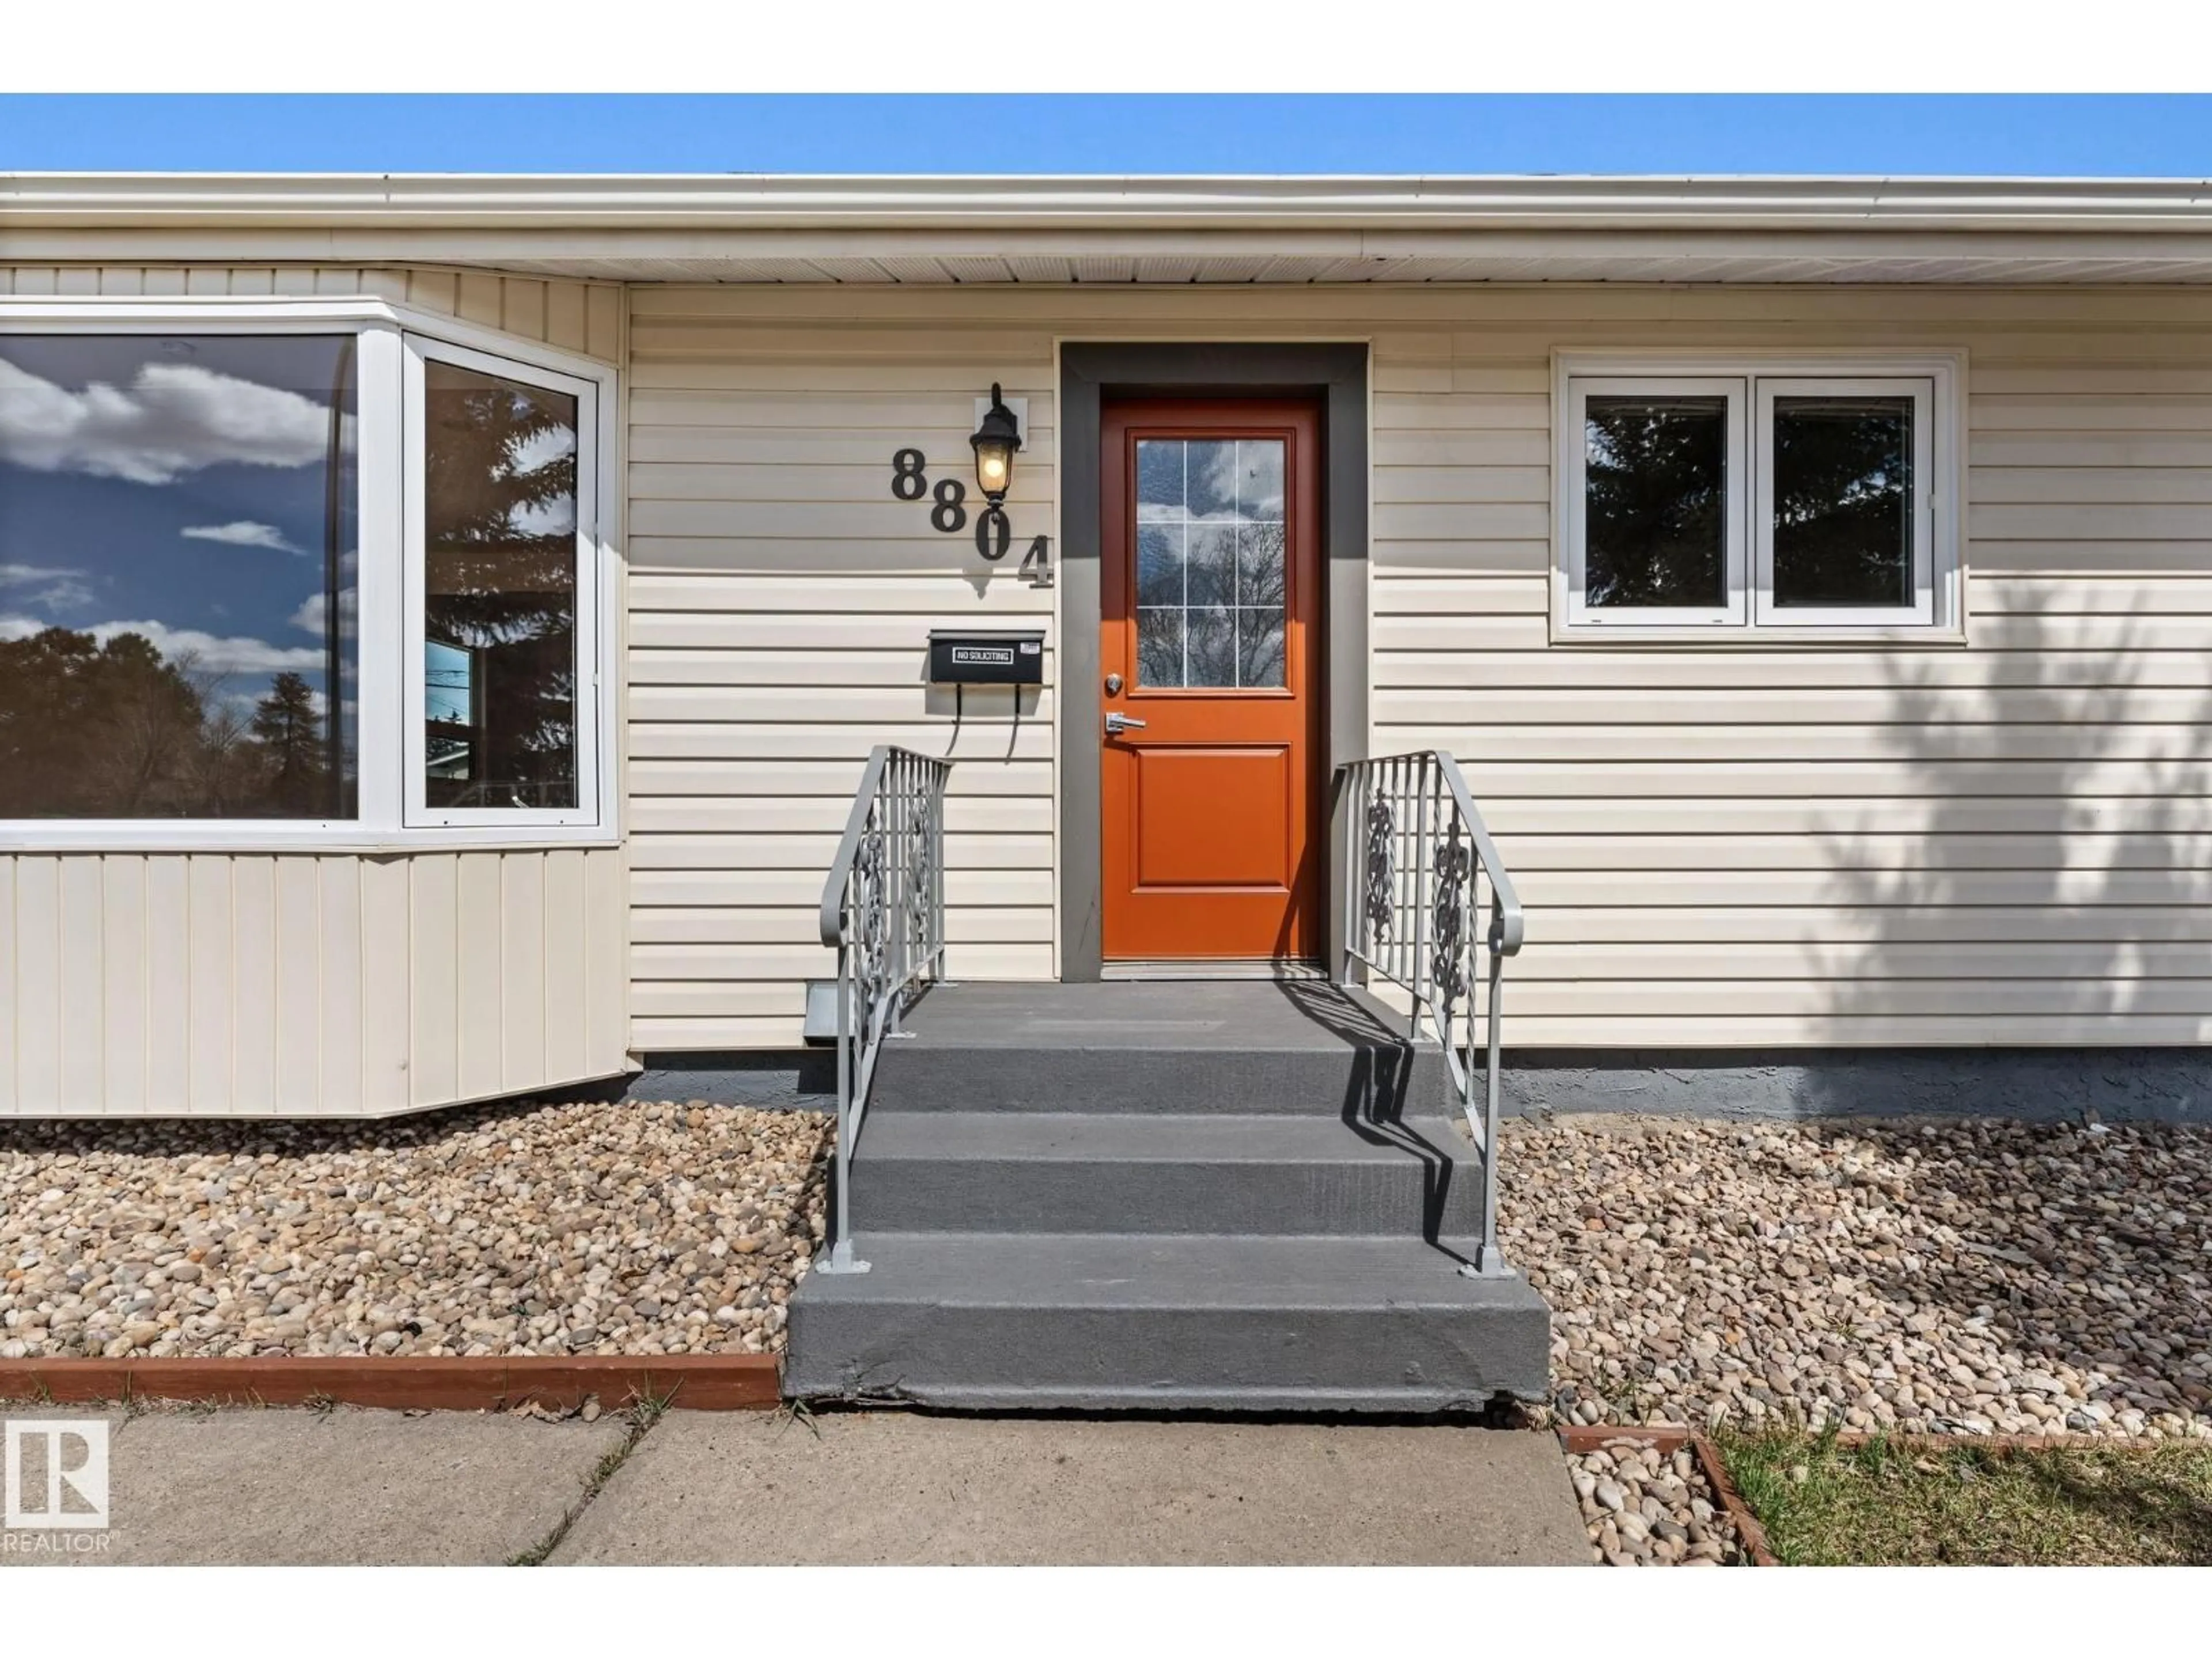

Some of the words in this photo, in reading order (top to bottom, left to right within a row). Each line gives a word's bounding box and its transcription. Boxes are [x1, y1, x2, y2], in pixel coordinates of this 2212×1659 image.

[891, 448, 1054, 588] 8804
[957, 651, 968, 660] NO
[969, 651, 1009, 661] SOLICITING
